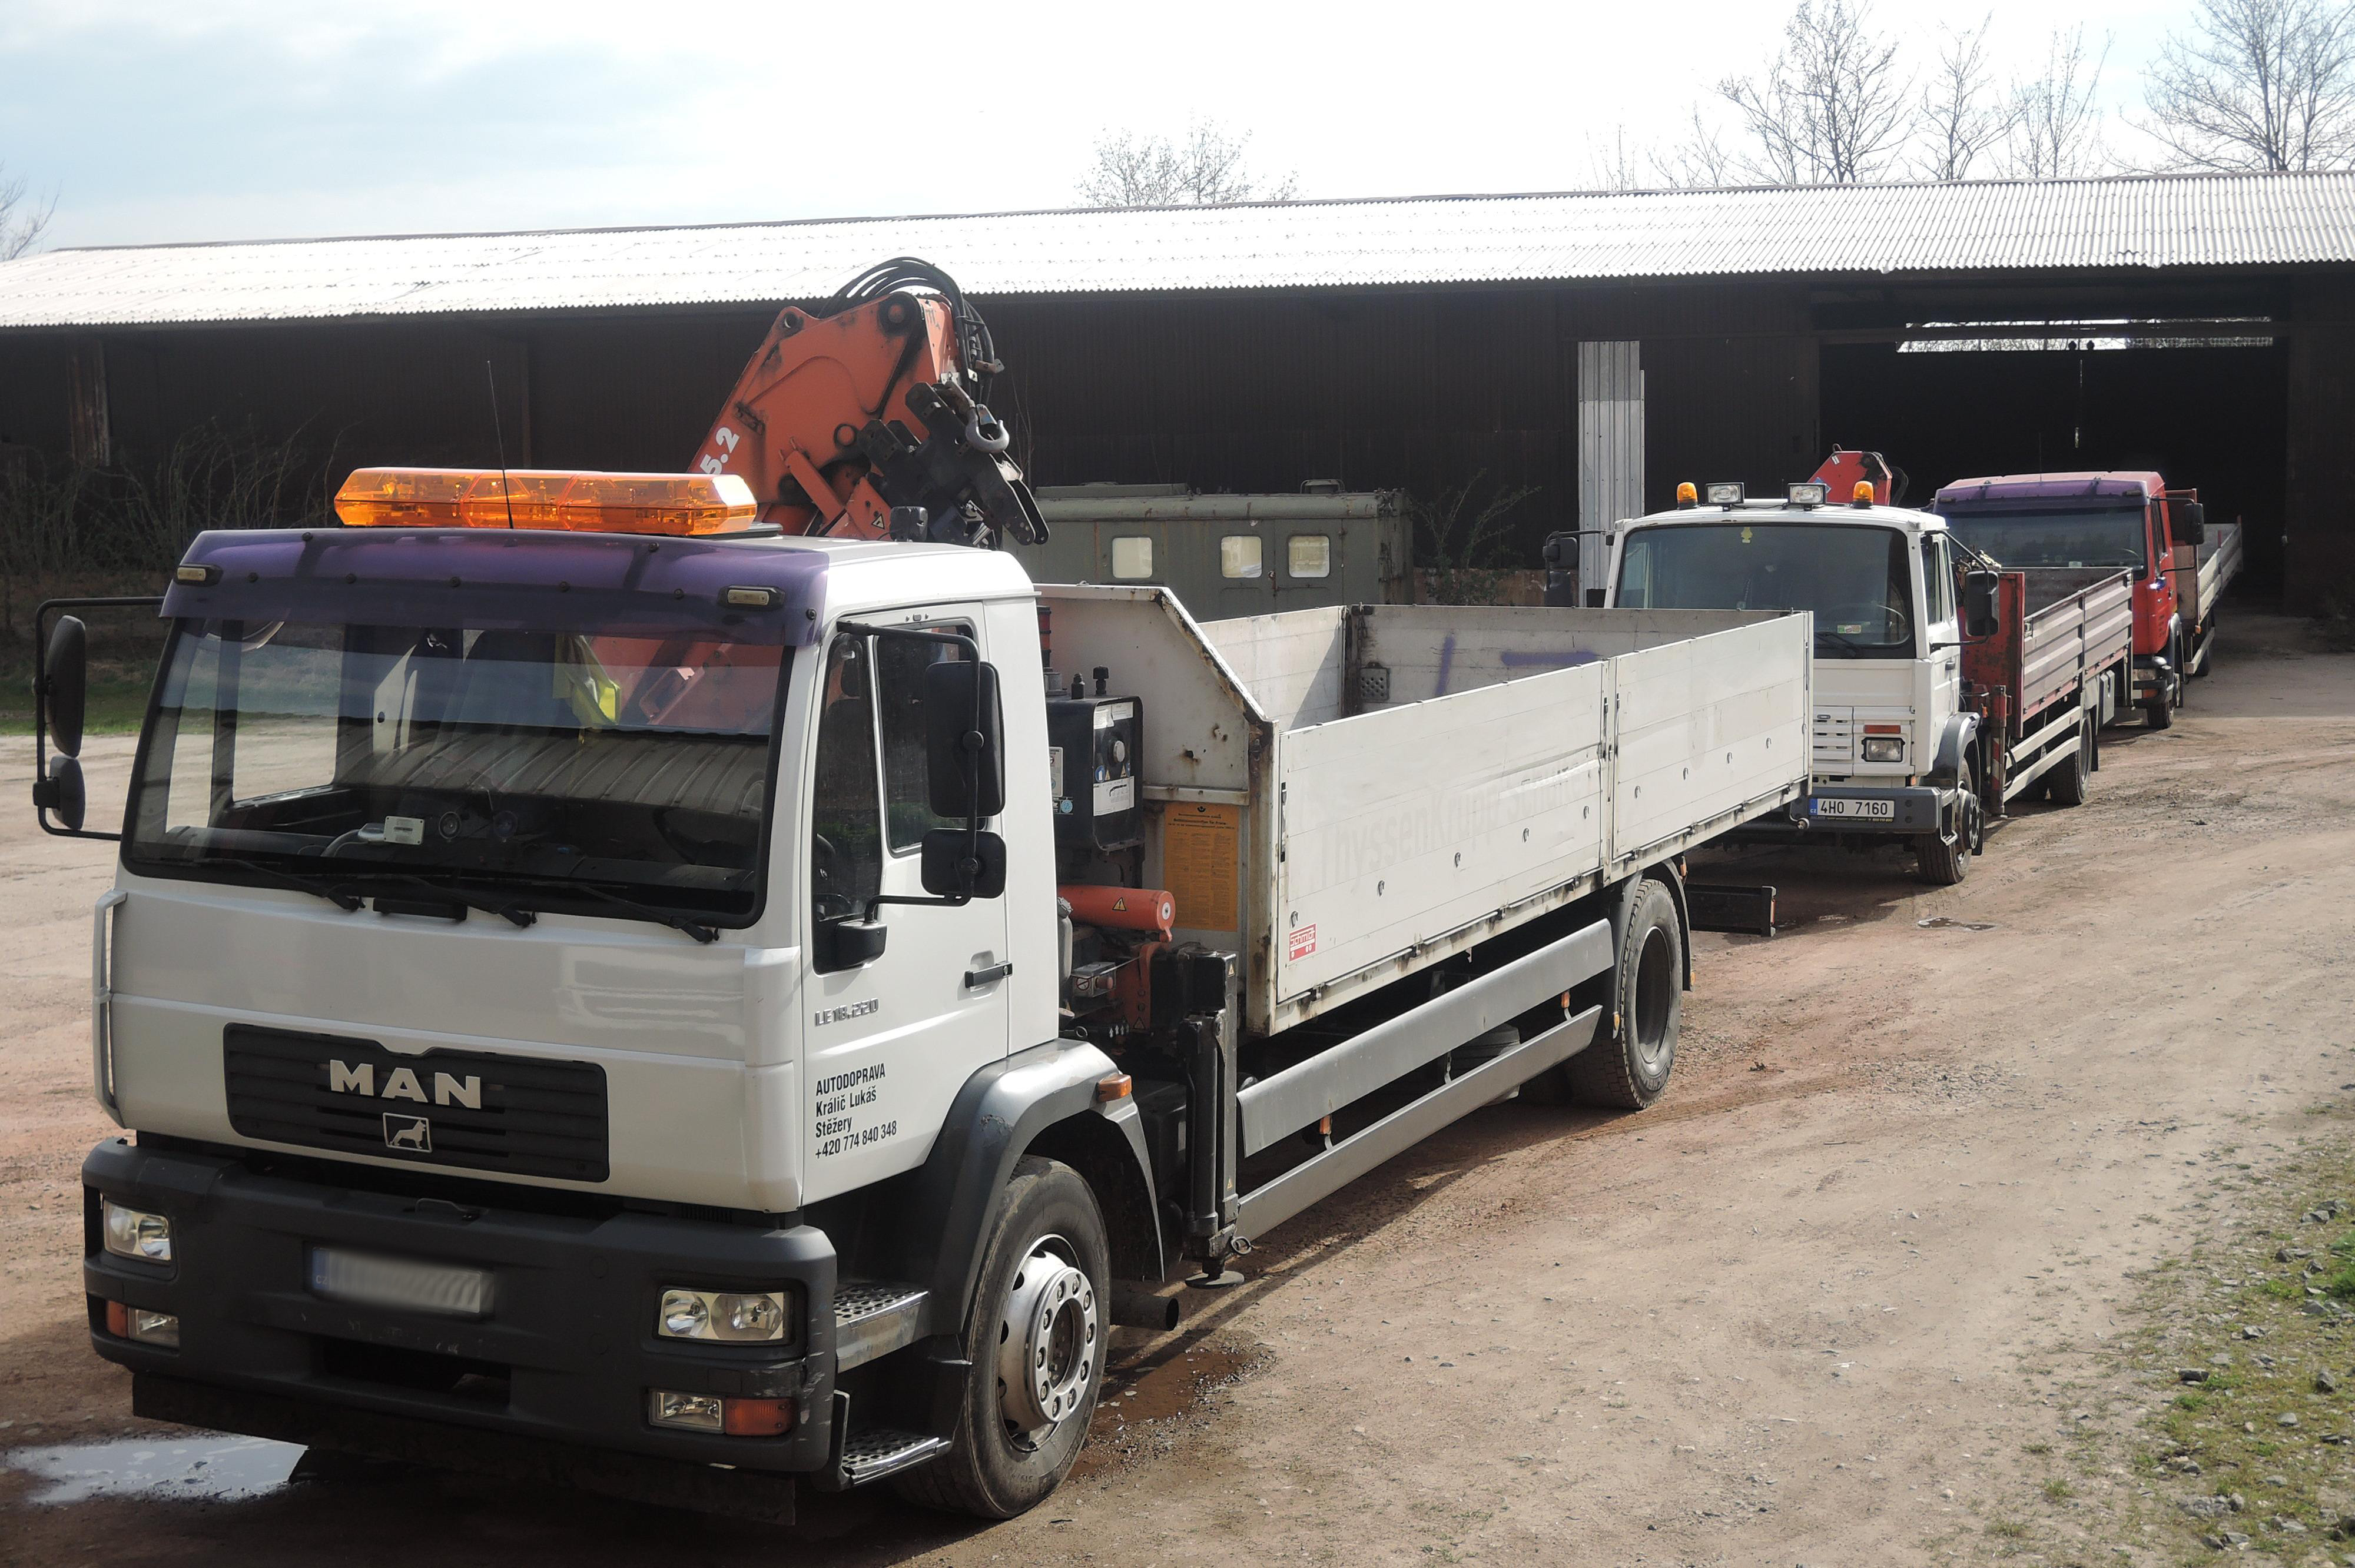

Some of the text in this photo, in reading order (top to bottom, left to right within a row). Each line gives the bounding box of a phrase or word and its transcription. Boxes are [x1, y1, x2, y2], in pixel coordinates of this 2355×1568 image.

[700, 427, 739, 475] 5.2
[1855, 802, 1888, 815] 7160
[1290, 927, 1315, 947] Schmidt
[815, 998, 878, 1026] LE18.220
[330, 1059, 481, 1109] MAN
[815, 1063, 886, 1096] AUTODOPRAVA
[816, 1085, 877, 1117] Králič Lukáš
[815, 1117, 853, 1138] Stěžery
[815, 1120, 897, 1159] +420 774 840 348
[316, 1274, 327, 1285] CZ
